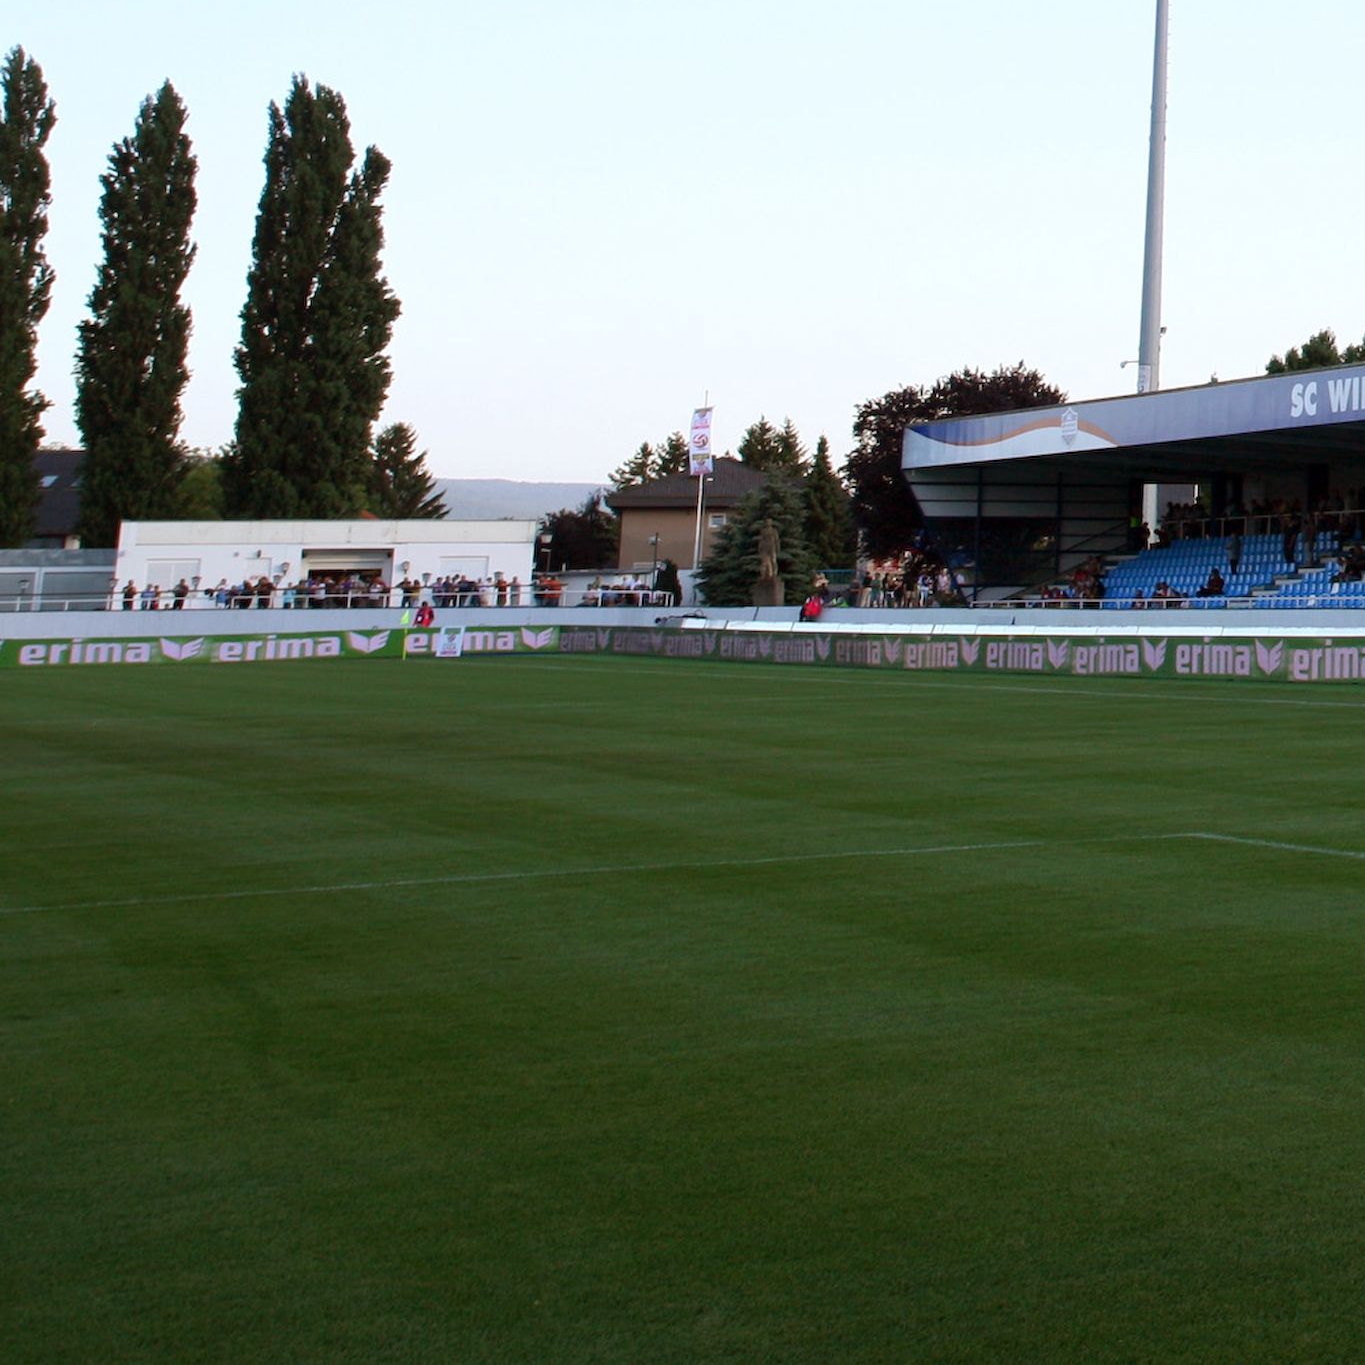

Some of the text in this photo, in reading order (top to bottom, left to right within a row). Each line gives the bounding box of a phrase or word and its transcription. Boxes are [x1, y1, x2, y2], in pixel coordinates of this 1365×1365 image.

[1290, 382, 1317, 418] SC
[19, 638, 150, 665] erima
[218, 635, 341, 662] erima
[405, 630, 515, 652] ema
[836, 635, 881, 664] erima
[903, 636, 958, 668] erima
[986, 636, 1043, 669] erima
[1074, 637, 1139, 673] erima
[1175, 637, 1250, 675] erima
